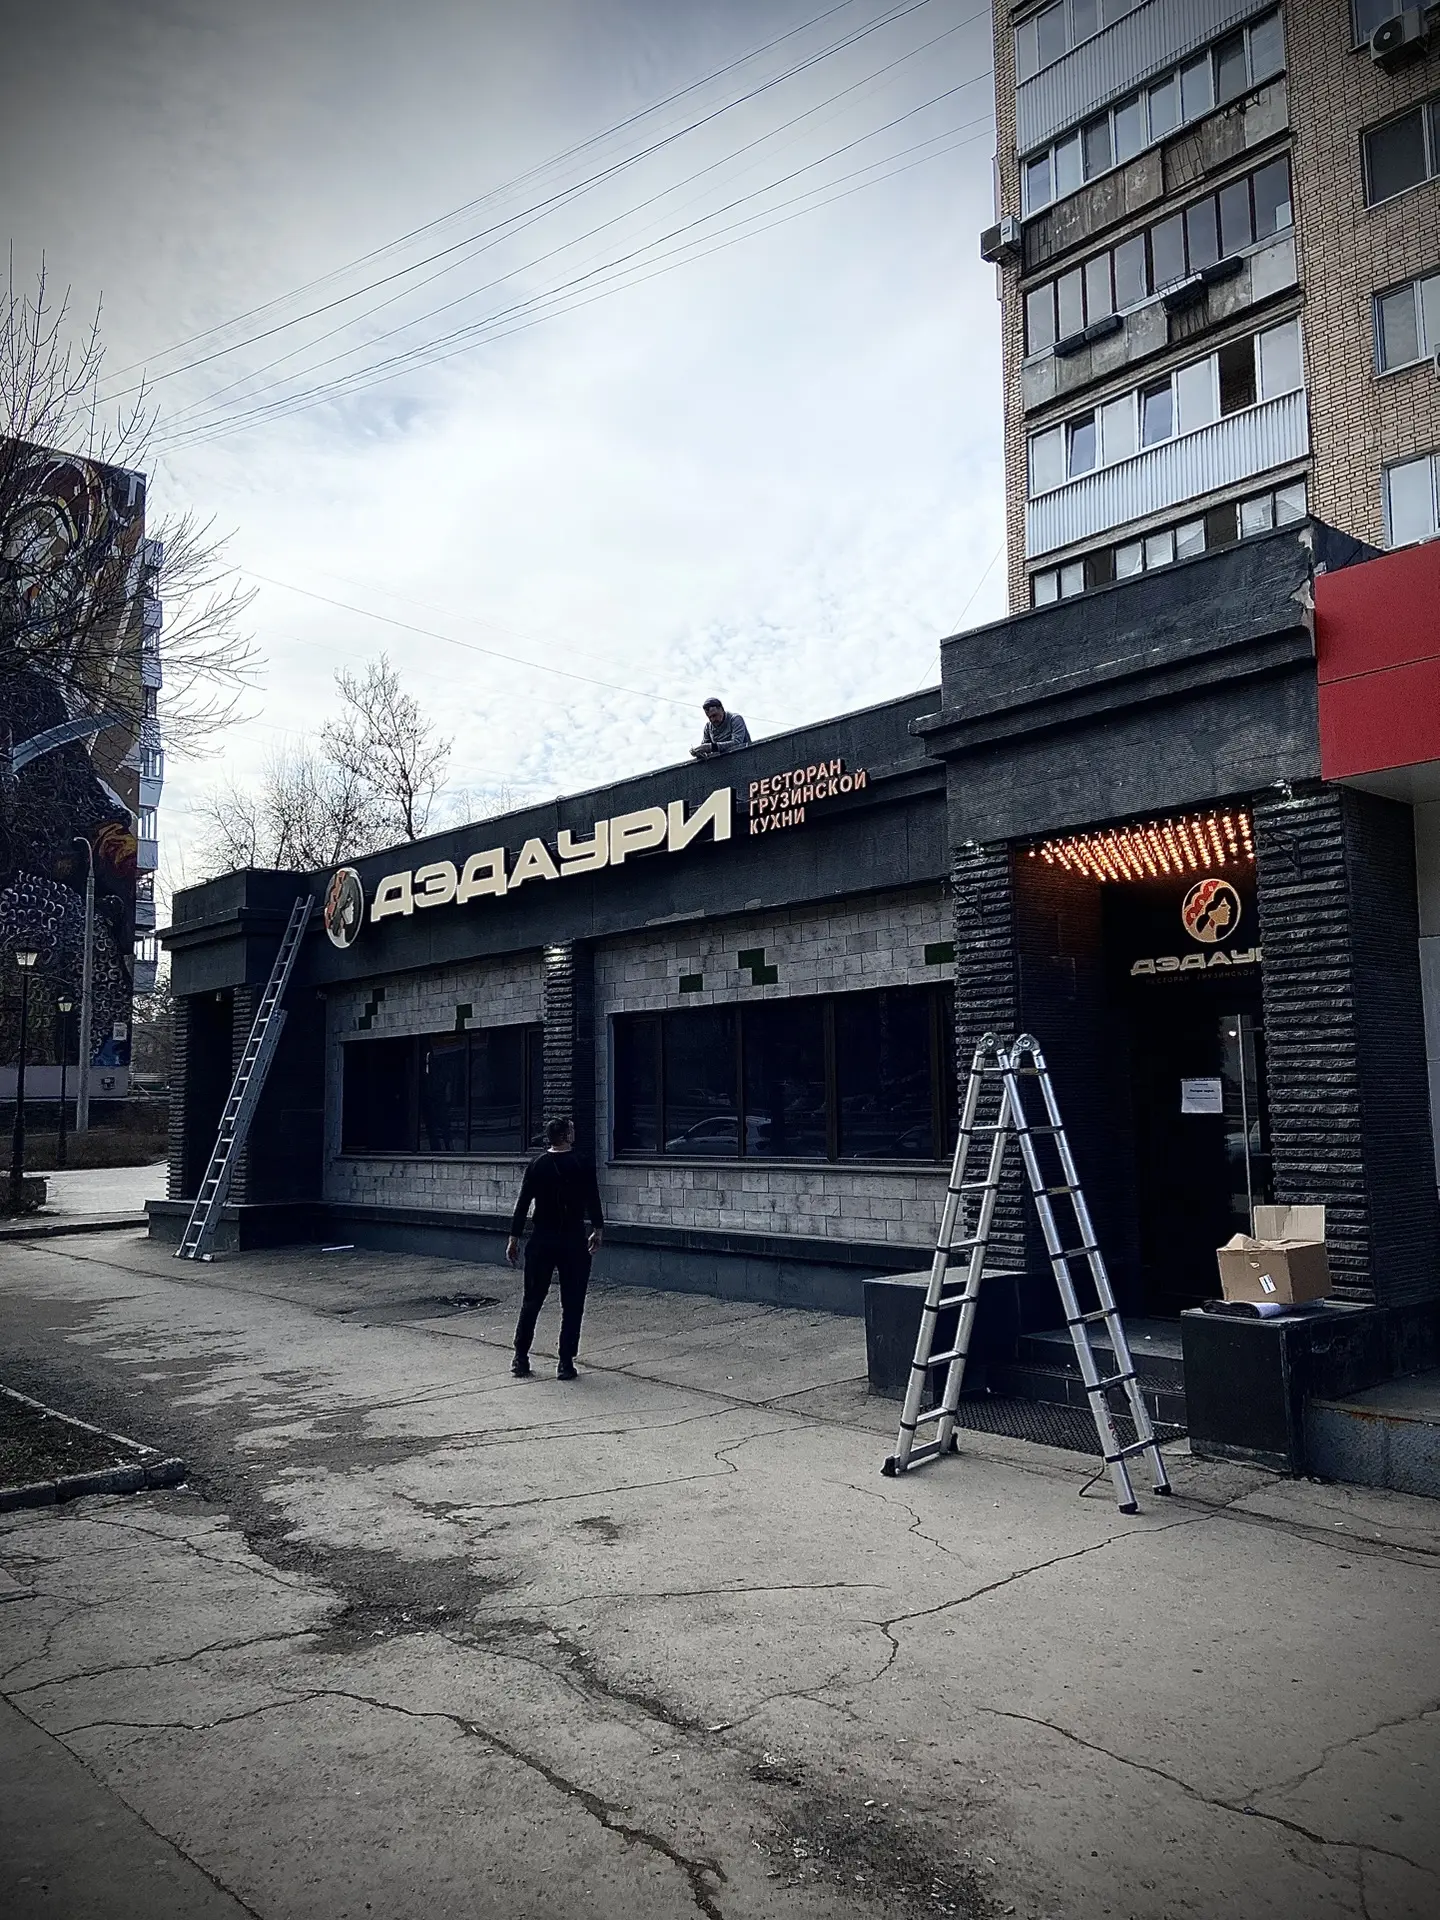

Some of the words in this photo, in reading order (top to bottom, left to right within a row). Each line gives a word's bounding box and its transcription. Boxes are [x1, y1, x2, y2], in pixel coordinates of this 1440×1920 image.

[749, 758, 841, 798] РЕСТОРАН
[749, 767, 866, 816] ГРУЗИНСКОЙ
[749, 807, 805, 835] КУХНИ
[371, 787, 732, 921] ДЭДАУРИ
